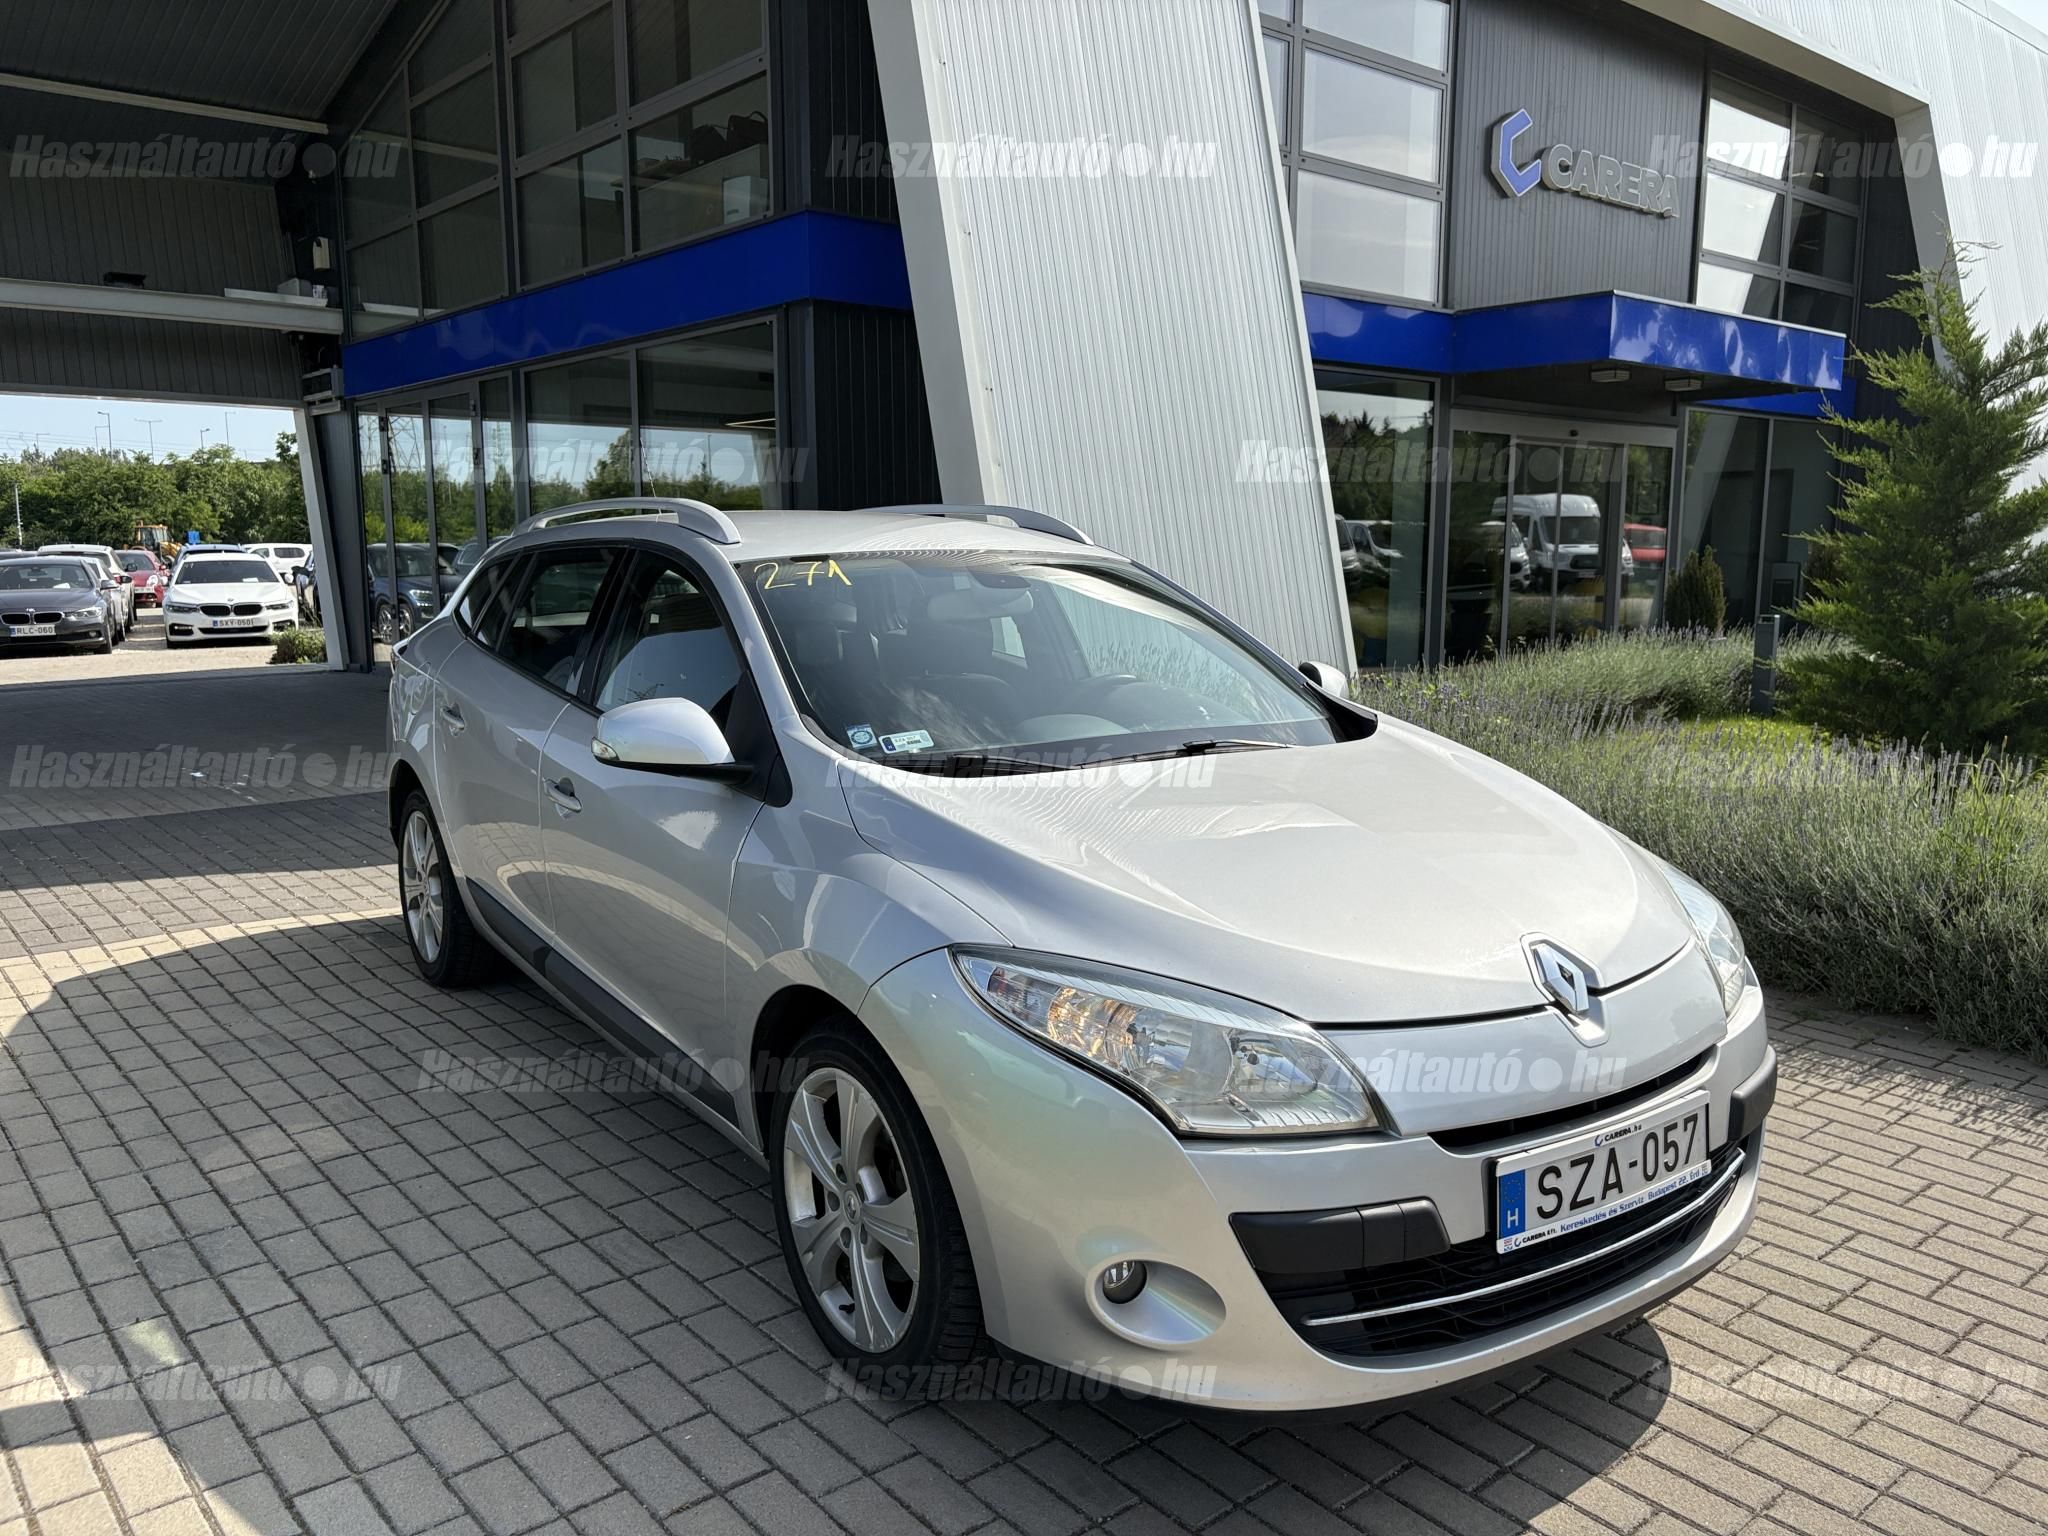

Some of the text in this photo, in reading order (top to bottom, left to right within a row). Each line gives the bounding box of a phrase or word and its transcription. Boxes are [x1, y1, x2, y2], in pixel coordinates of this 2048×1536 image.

[1545, 144, 1681, 219] CARERA
[1536, 1112, 1699, 1220] SZA-057
[1507, 1207, 1519, 1229] H
[1560, 1211, 1607, 1233] Kereskedés
[1619, 1197, 1645, 1212] Szerviz
[1647, 1180, 1678, 1200] Budapest
